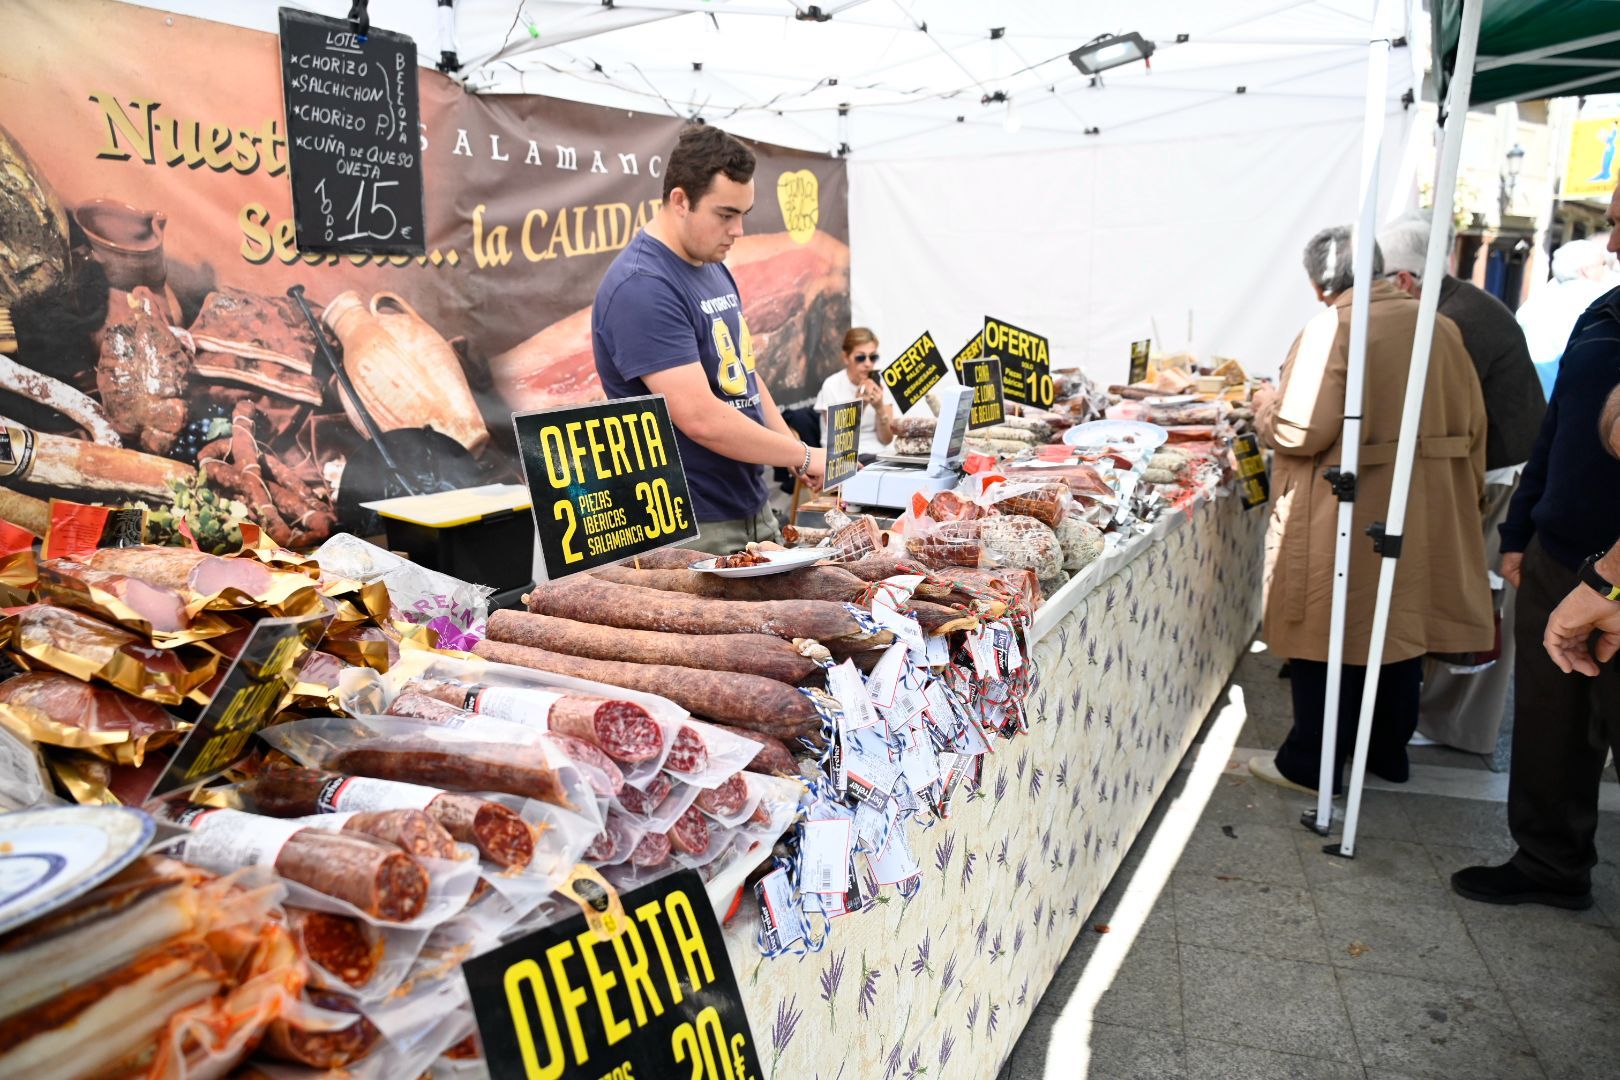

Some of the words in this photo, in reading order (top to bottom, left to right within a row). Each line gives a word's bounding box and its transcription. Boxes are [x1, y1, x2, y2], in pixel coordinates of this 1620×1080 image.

[326, 32, 361, 49] LOTE
[299, 74, 384, 102] SALCHICHON
[395, 52, 408, 145] BELLOTA
[89, 95, 289, 178] Nuest
[302, 134, 346, 157] CUÑA
[366, 146, 414, 168] QUESO
[420, 122, 662, 180] SALAMANC
[336, 158, 381, 180] OVEJA
[472, 203, 513, 270] la
[884, 334, 936, 388] OFERTA
[955, 333, 984, 371] OFERT
[985, 321, 1050, 366] OFERTA
[1026, 371, 1055, 406] 10
[539, 411, 668, 489] OFERTA
[577, 490, 613, 514] PIEZAS
[553, 499, 584, 565] 2
[586, 524, 645, 557] SALAMANCA
[503, 889, 716, 1080] OFERTA
